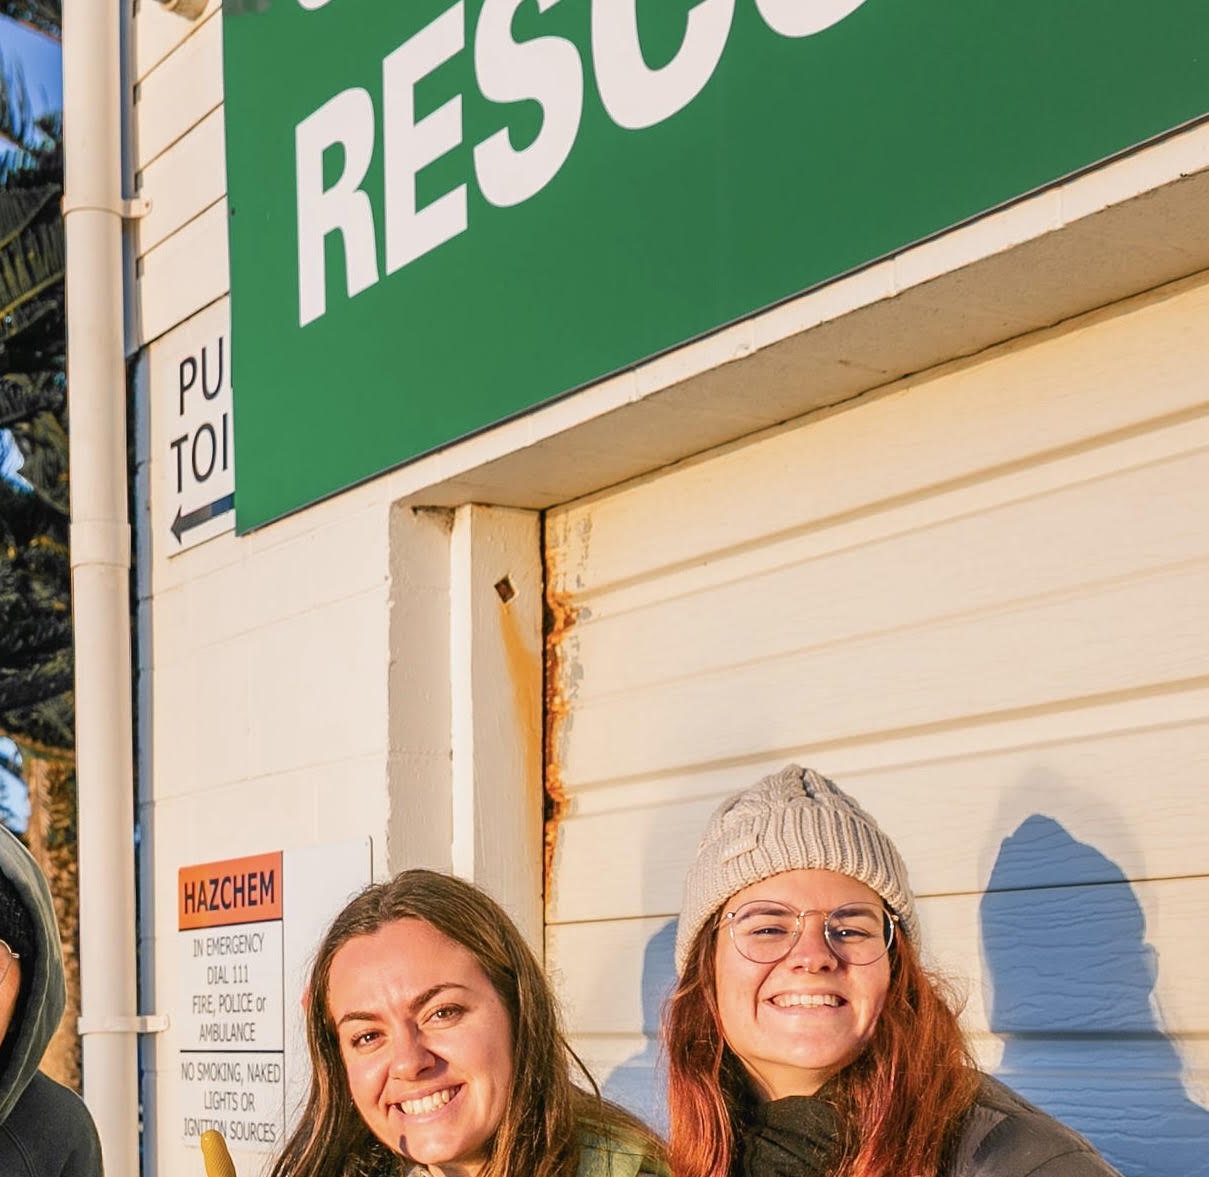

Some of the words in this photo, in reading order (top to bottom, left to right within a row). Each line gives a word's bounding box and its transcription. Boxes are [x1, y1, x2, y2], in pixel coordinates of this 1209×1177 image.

[296, 0, 869, 328] RESC
[179, 336, 224, 417] PU
[170, 412, 228, 494] TOI
[184, 869, 275, 915] HAZCHEM
[193, 938, 203, 957] IN
[206, 932, 265, 956] EMERGENCY
[207, 965, 229, 985] DIAL
[232, 964, 249, 984] 111
[192, 994, 216, 1017] FIRE,
[218, 993, 254, 1013] POLICE
[256, 996, 267, 1013] or
[199, 1022, 256, 1043] AMBULANCE
[181, 1062, 195, 1082] NO
[197, 1062, 244, 1086] SMOKING,
[247, 1063, 281, 1083] NAKED
[204, 1091, 239, 1112] LIGHTS
[241, 1092, 256, 1112] OR
[230, 1120, 276, 1143] SOURCES
